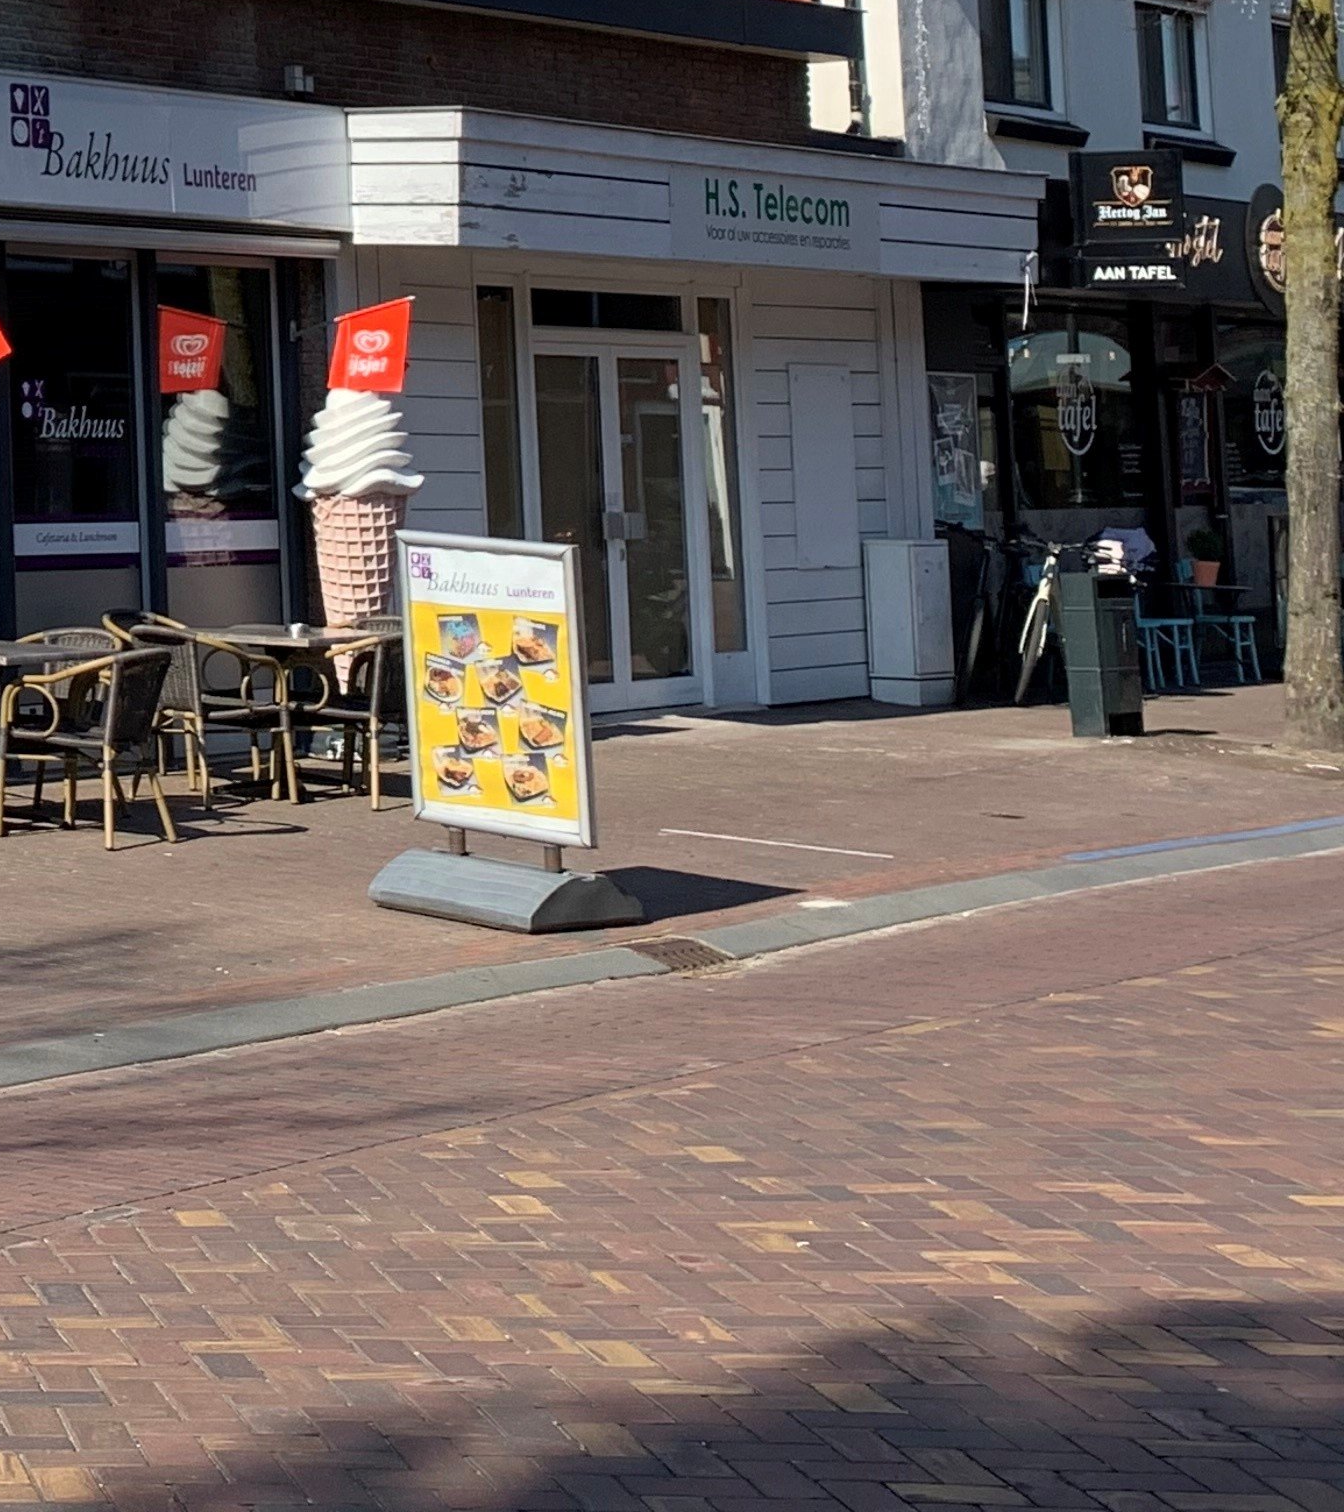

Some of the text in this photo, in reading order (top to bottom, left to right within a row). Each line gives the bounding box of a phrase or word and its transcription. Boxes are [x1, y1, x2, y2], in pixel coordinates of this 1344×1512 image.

[41, 131, 170, 185] Bakhuus
[183, 163, 257, 192] Lunteren
[705, 178, 850, 227] H.S. Telecom
[1098, 205, 1167, 221] Hertog Jan
[705, 224, 725, 240] Voor
[1093, 265, 1177, 280] AAN TAFEL
[39, 405, 125, 439] Bakhuus
[1057, 394, 1097, 442] tafel
[1255, 399, 1284, 443] tafe
[427, 571, 498, 596] Bakhuus
[506, 585, 555, 599] Lunteren
